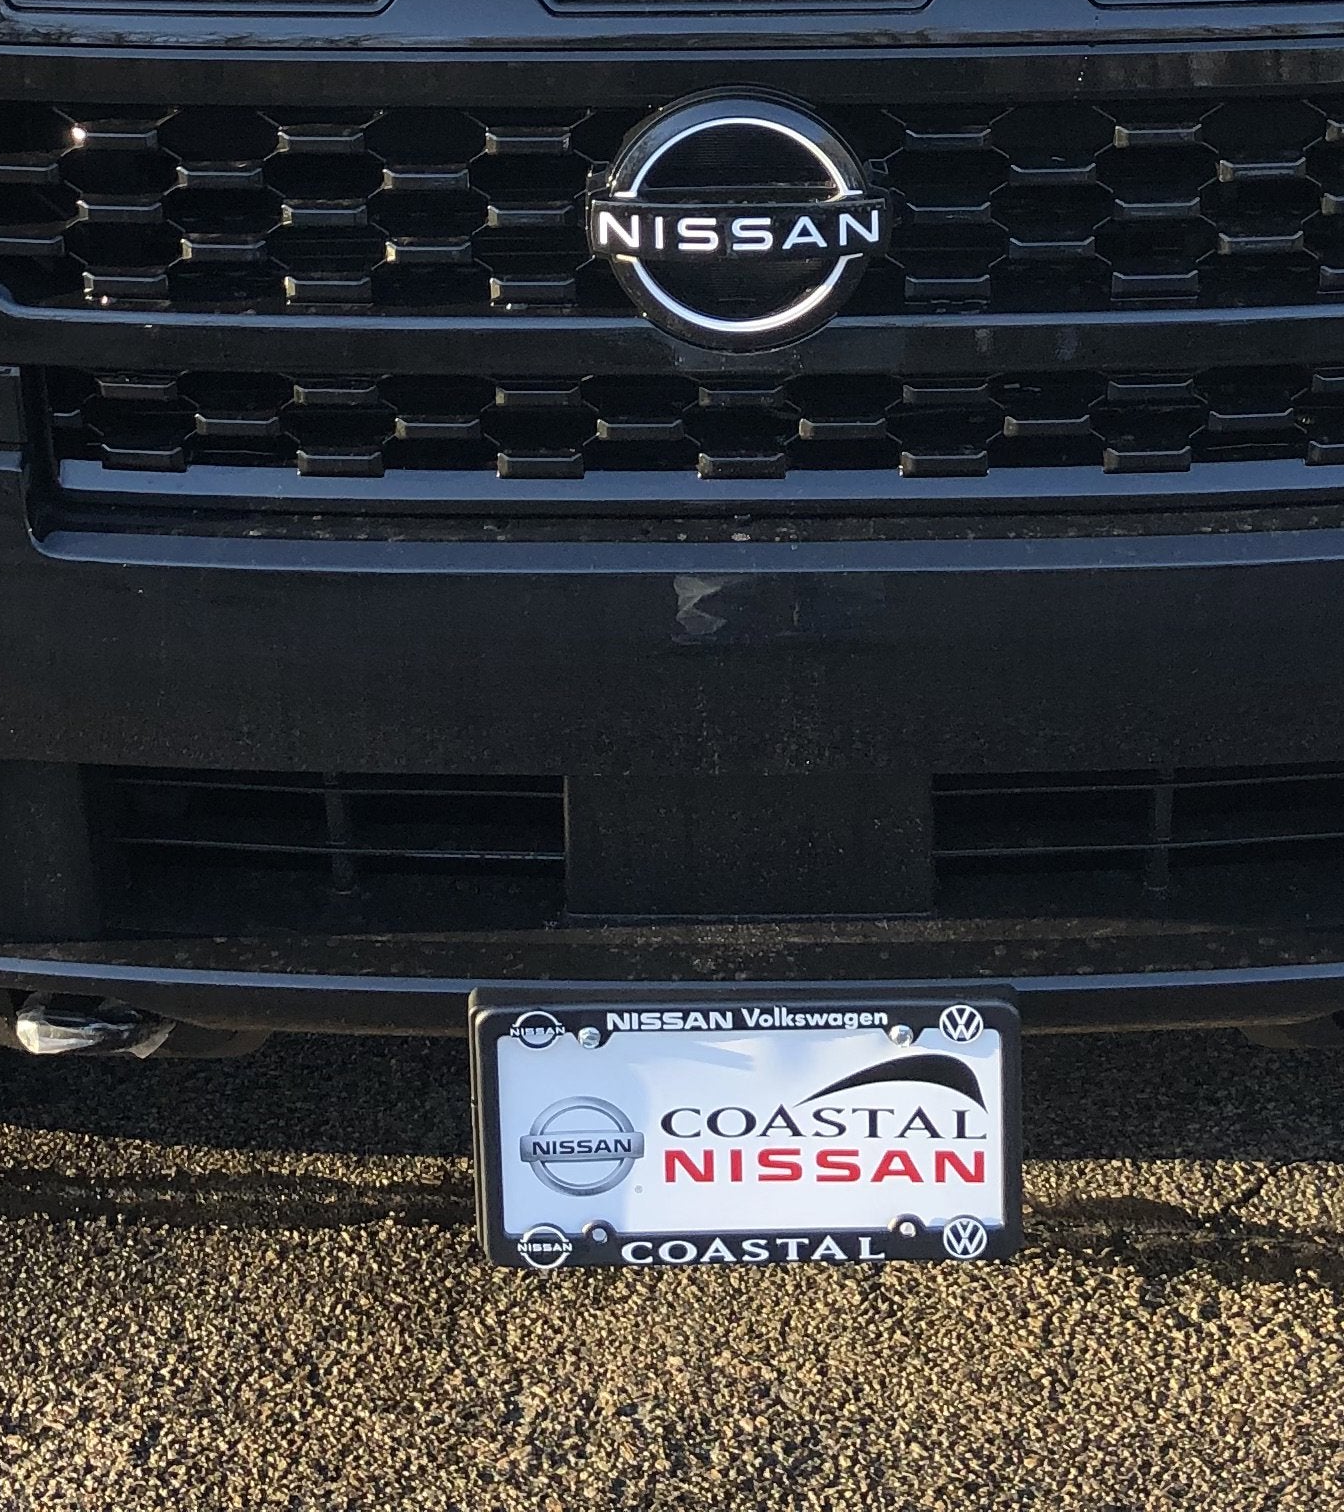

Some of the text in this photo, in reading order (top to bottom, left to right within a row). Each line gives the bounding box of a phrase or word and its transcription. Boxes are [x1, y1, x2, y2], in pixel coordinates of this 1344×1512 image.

[598, 209, 880, 251] NISSAN
[510, 1025, 565, 1037] NISSAN
[607, 1005, 888, 1031] NISSAN Volkswagen
[661, 1103, 987, 1140] COASTAL
[531, 1136, 633, 1157] NISSAN
[664, 1147, 985, 1184] NISSAN
[517, 1242, 573, 1253] NISSAN
[621, 1234, 886, 1264] COASTAL
